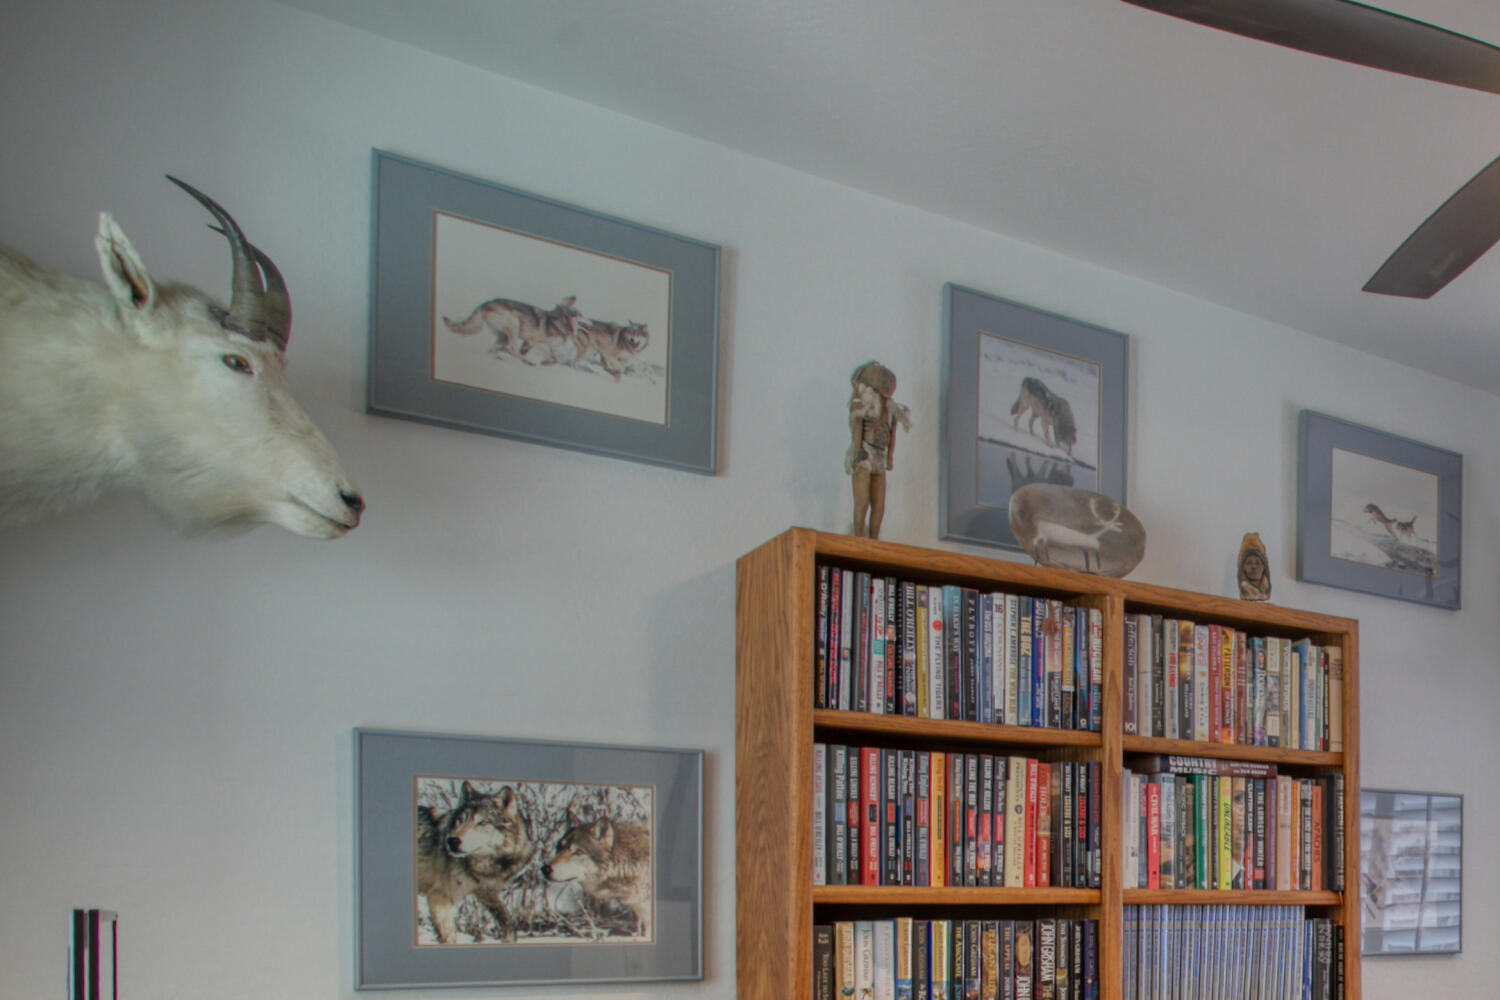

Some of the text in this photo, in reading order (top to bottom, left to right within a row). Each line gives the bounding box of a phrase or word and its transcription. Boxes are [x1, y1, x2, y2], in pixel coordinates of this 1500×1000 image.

[1041, 923, 1055, 982] JOHN GRISHAM
[1016, 976, 1031, 996] JOHN
